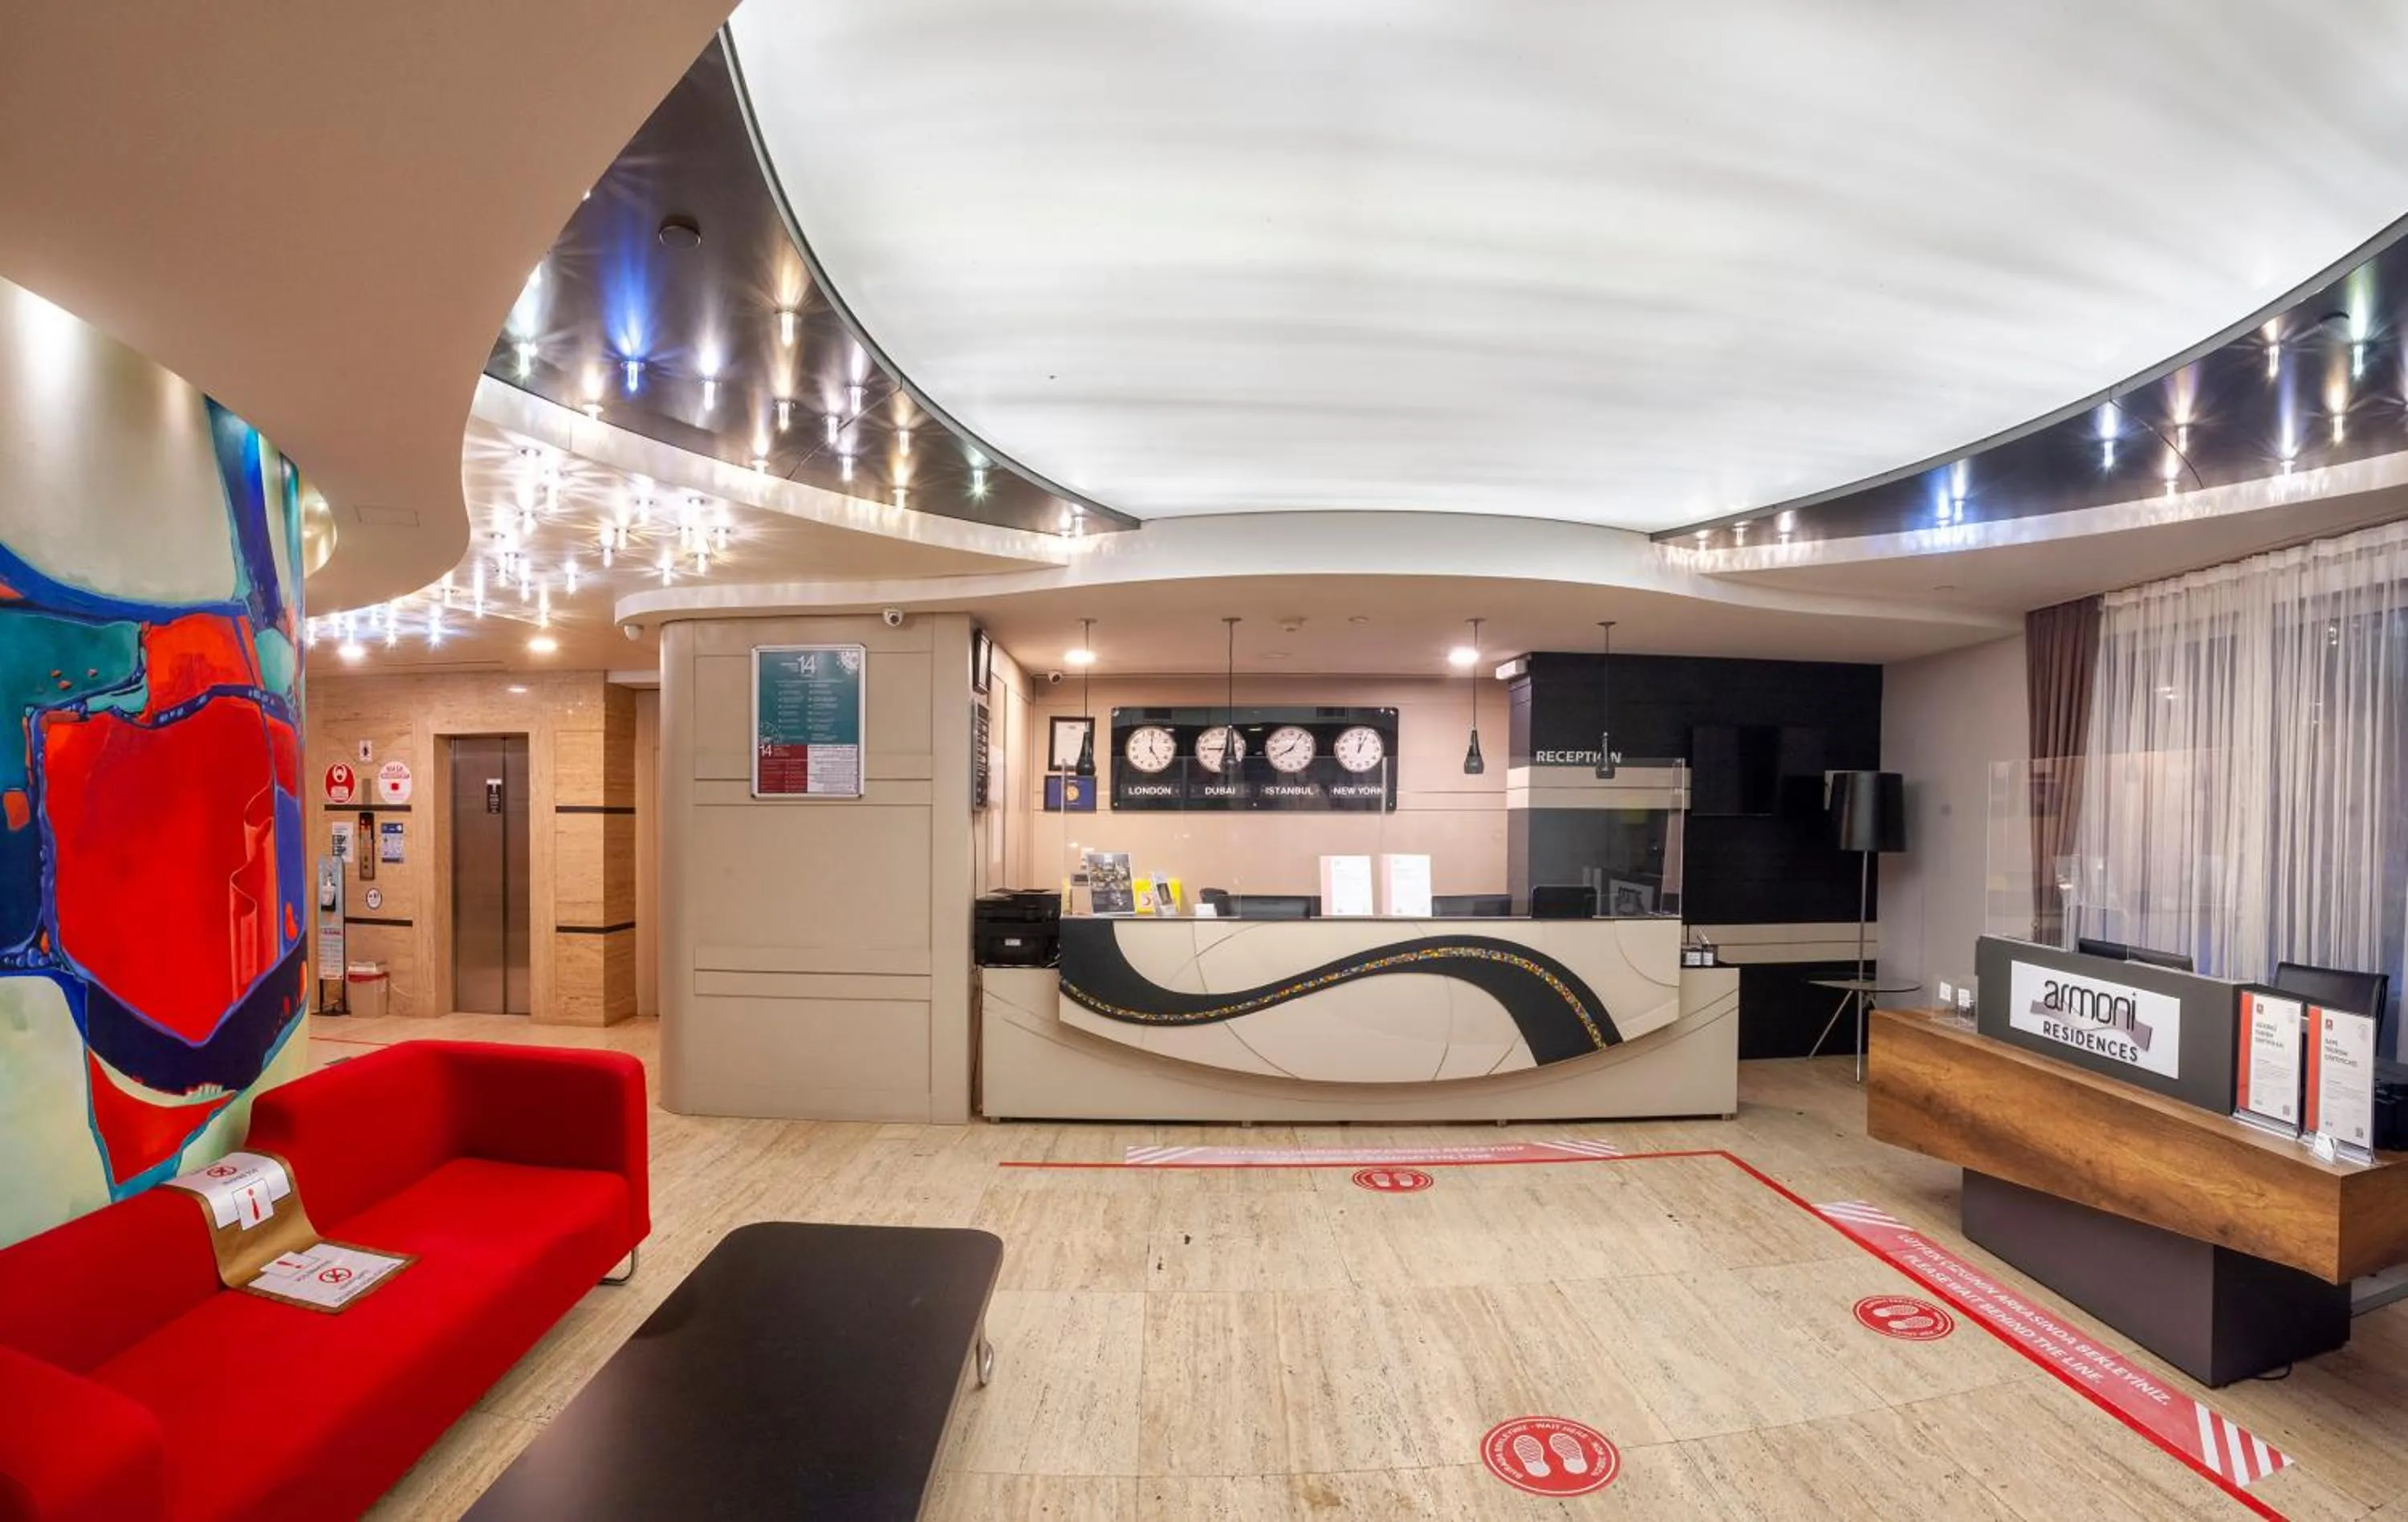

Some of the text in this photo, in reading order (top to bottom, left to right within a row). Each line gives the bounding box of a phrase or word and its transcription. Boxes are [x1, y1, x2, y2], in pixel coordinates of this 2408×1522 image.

[796, 655, 817, 674] 14
[759, 744, 771, 757] 14
[1128, 786, 1172, 796] LONDON
[1205, 786, 1235, 796] DUBAI
[1333, 786, 1357, 796] NEW
[2044, 980, 2138, 1032] armoni
[2043, 1020, 2138, 1062] RESIDENCES
[1902, 1254, 1953, 1284] PLEASE
[1946, 1282, 1985, 1304] WAIT
[1979, 1302, 2036, 1338] BEHIND
[2034, 1337, 2068, 1359] THE
[1995, 1294, 2078, 1345] ARKASINDA
[1535, 1422, 1560, 1431] WAIT
